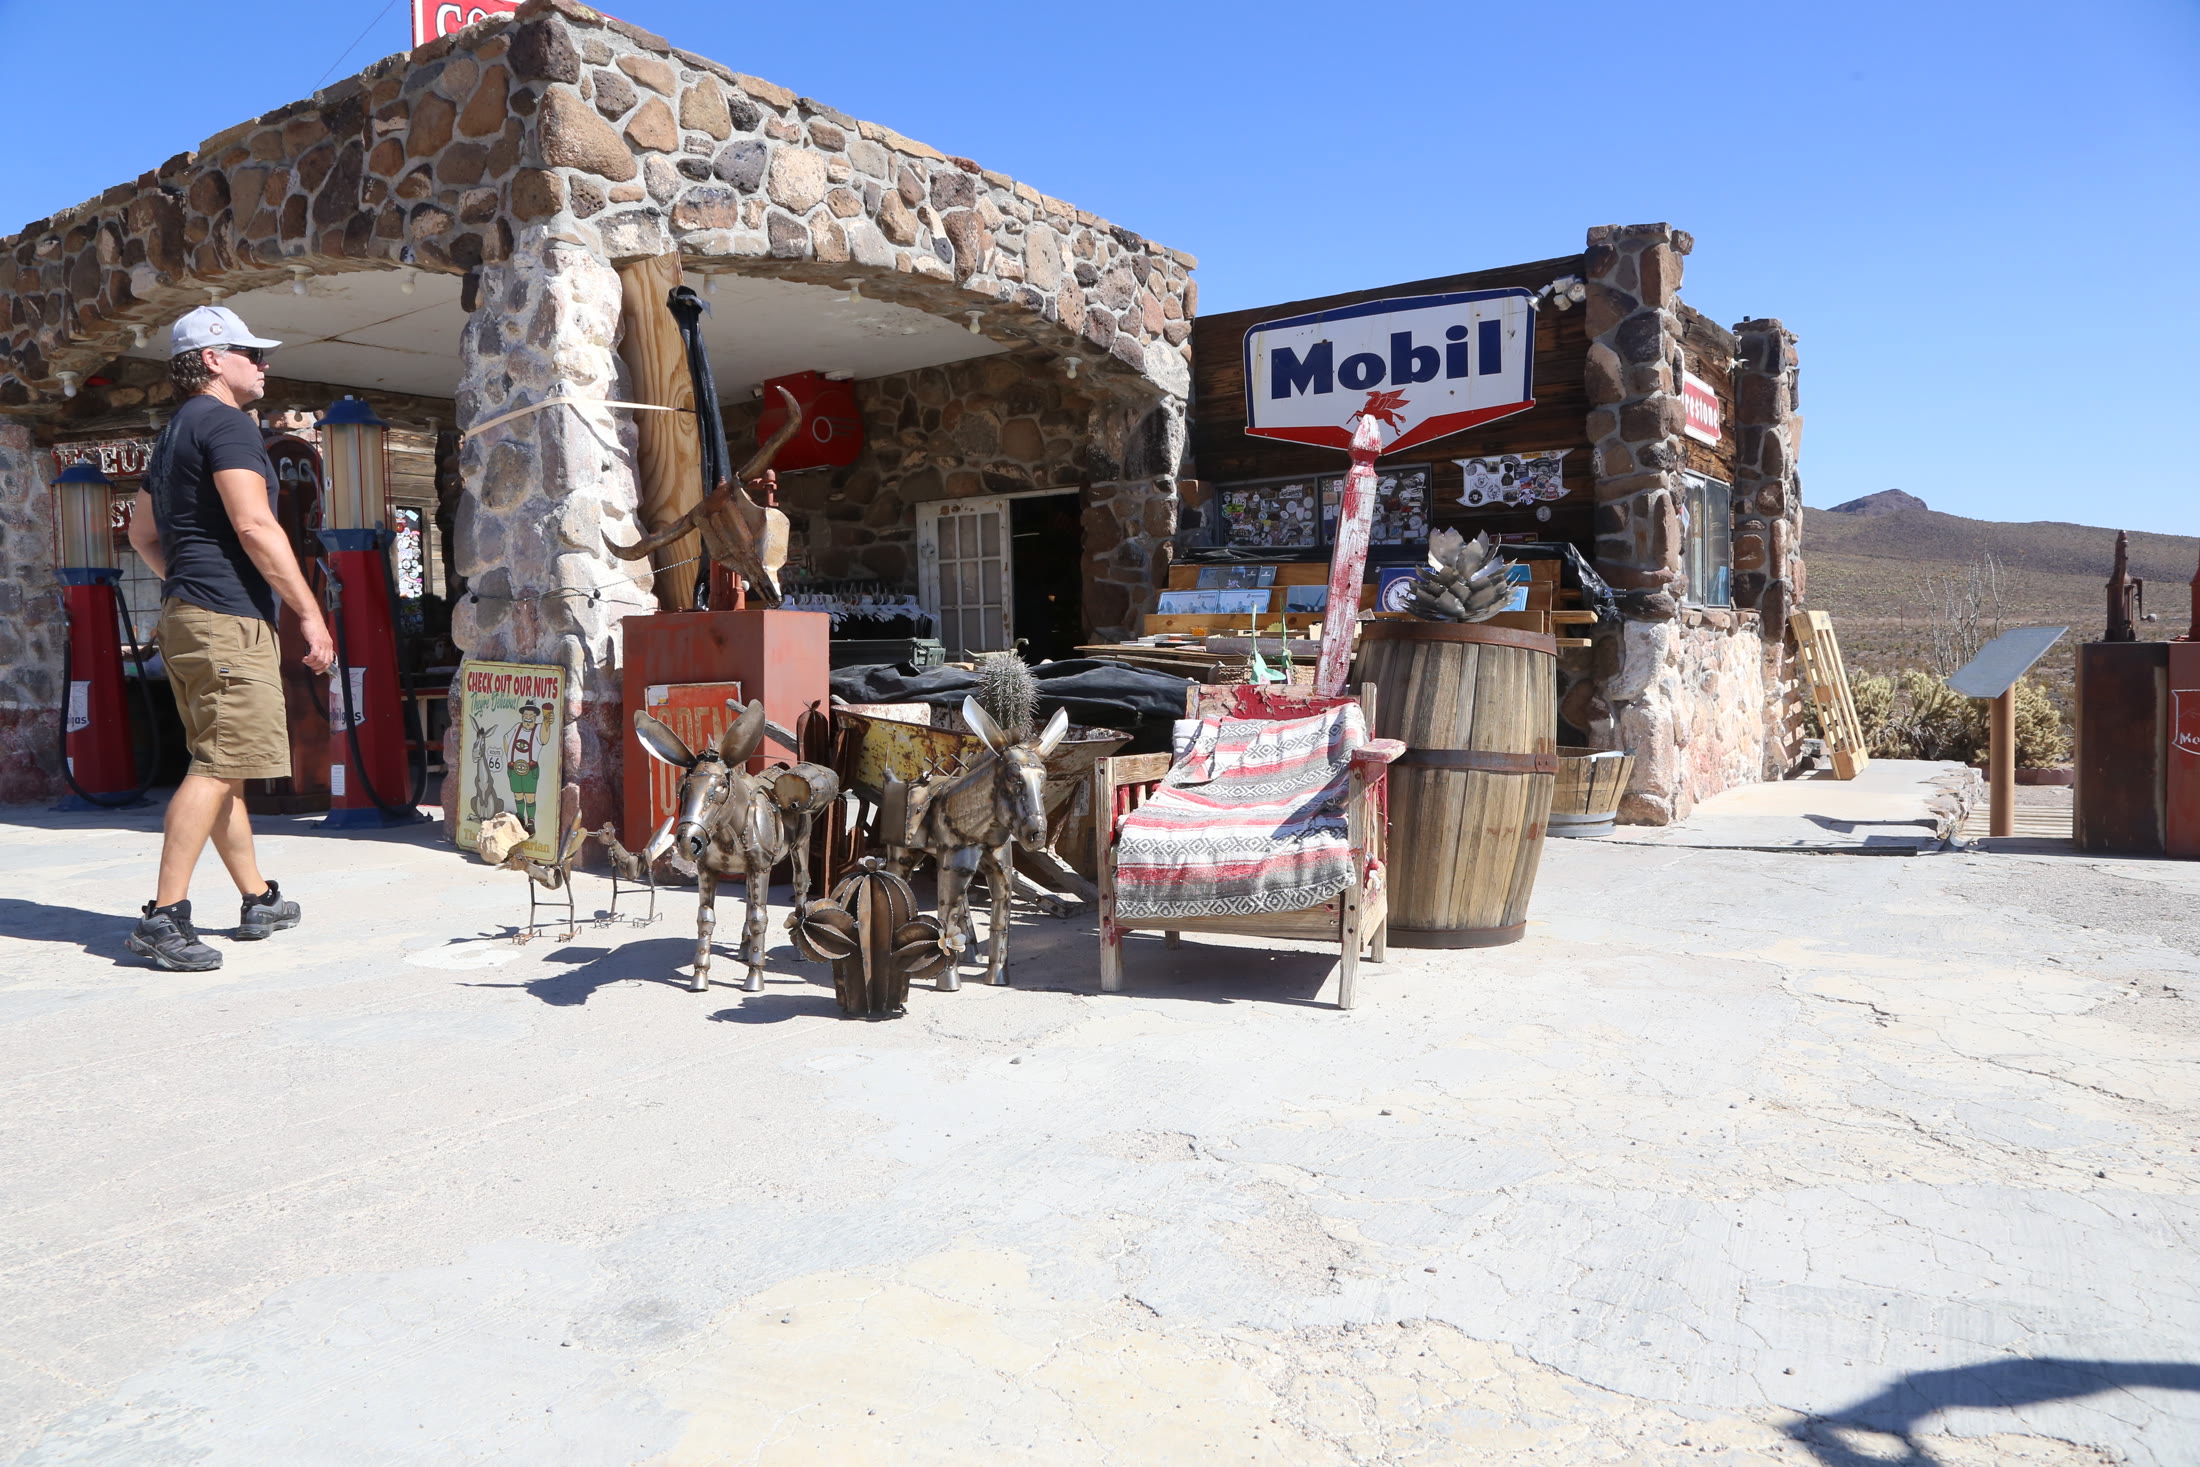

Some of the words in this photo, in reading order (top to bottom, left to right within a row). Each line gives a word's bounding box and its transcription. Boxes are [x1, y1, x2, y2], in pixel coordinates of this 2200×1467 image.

[1271, 319, 1502, 400] Mobil
[1677, 391, 1718, 430] irestone
[467, 671, 493, 694] CHECK
[494, 674, 512, 694] OUT
[513, 676, 532, 697] OUR
[534, 676, 558, 699] NUTS
[491, 690, 520, 712] Delicious!
[488, 756, 501, 770] 66
[521, 840, 550, 853] arian
